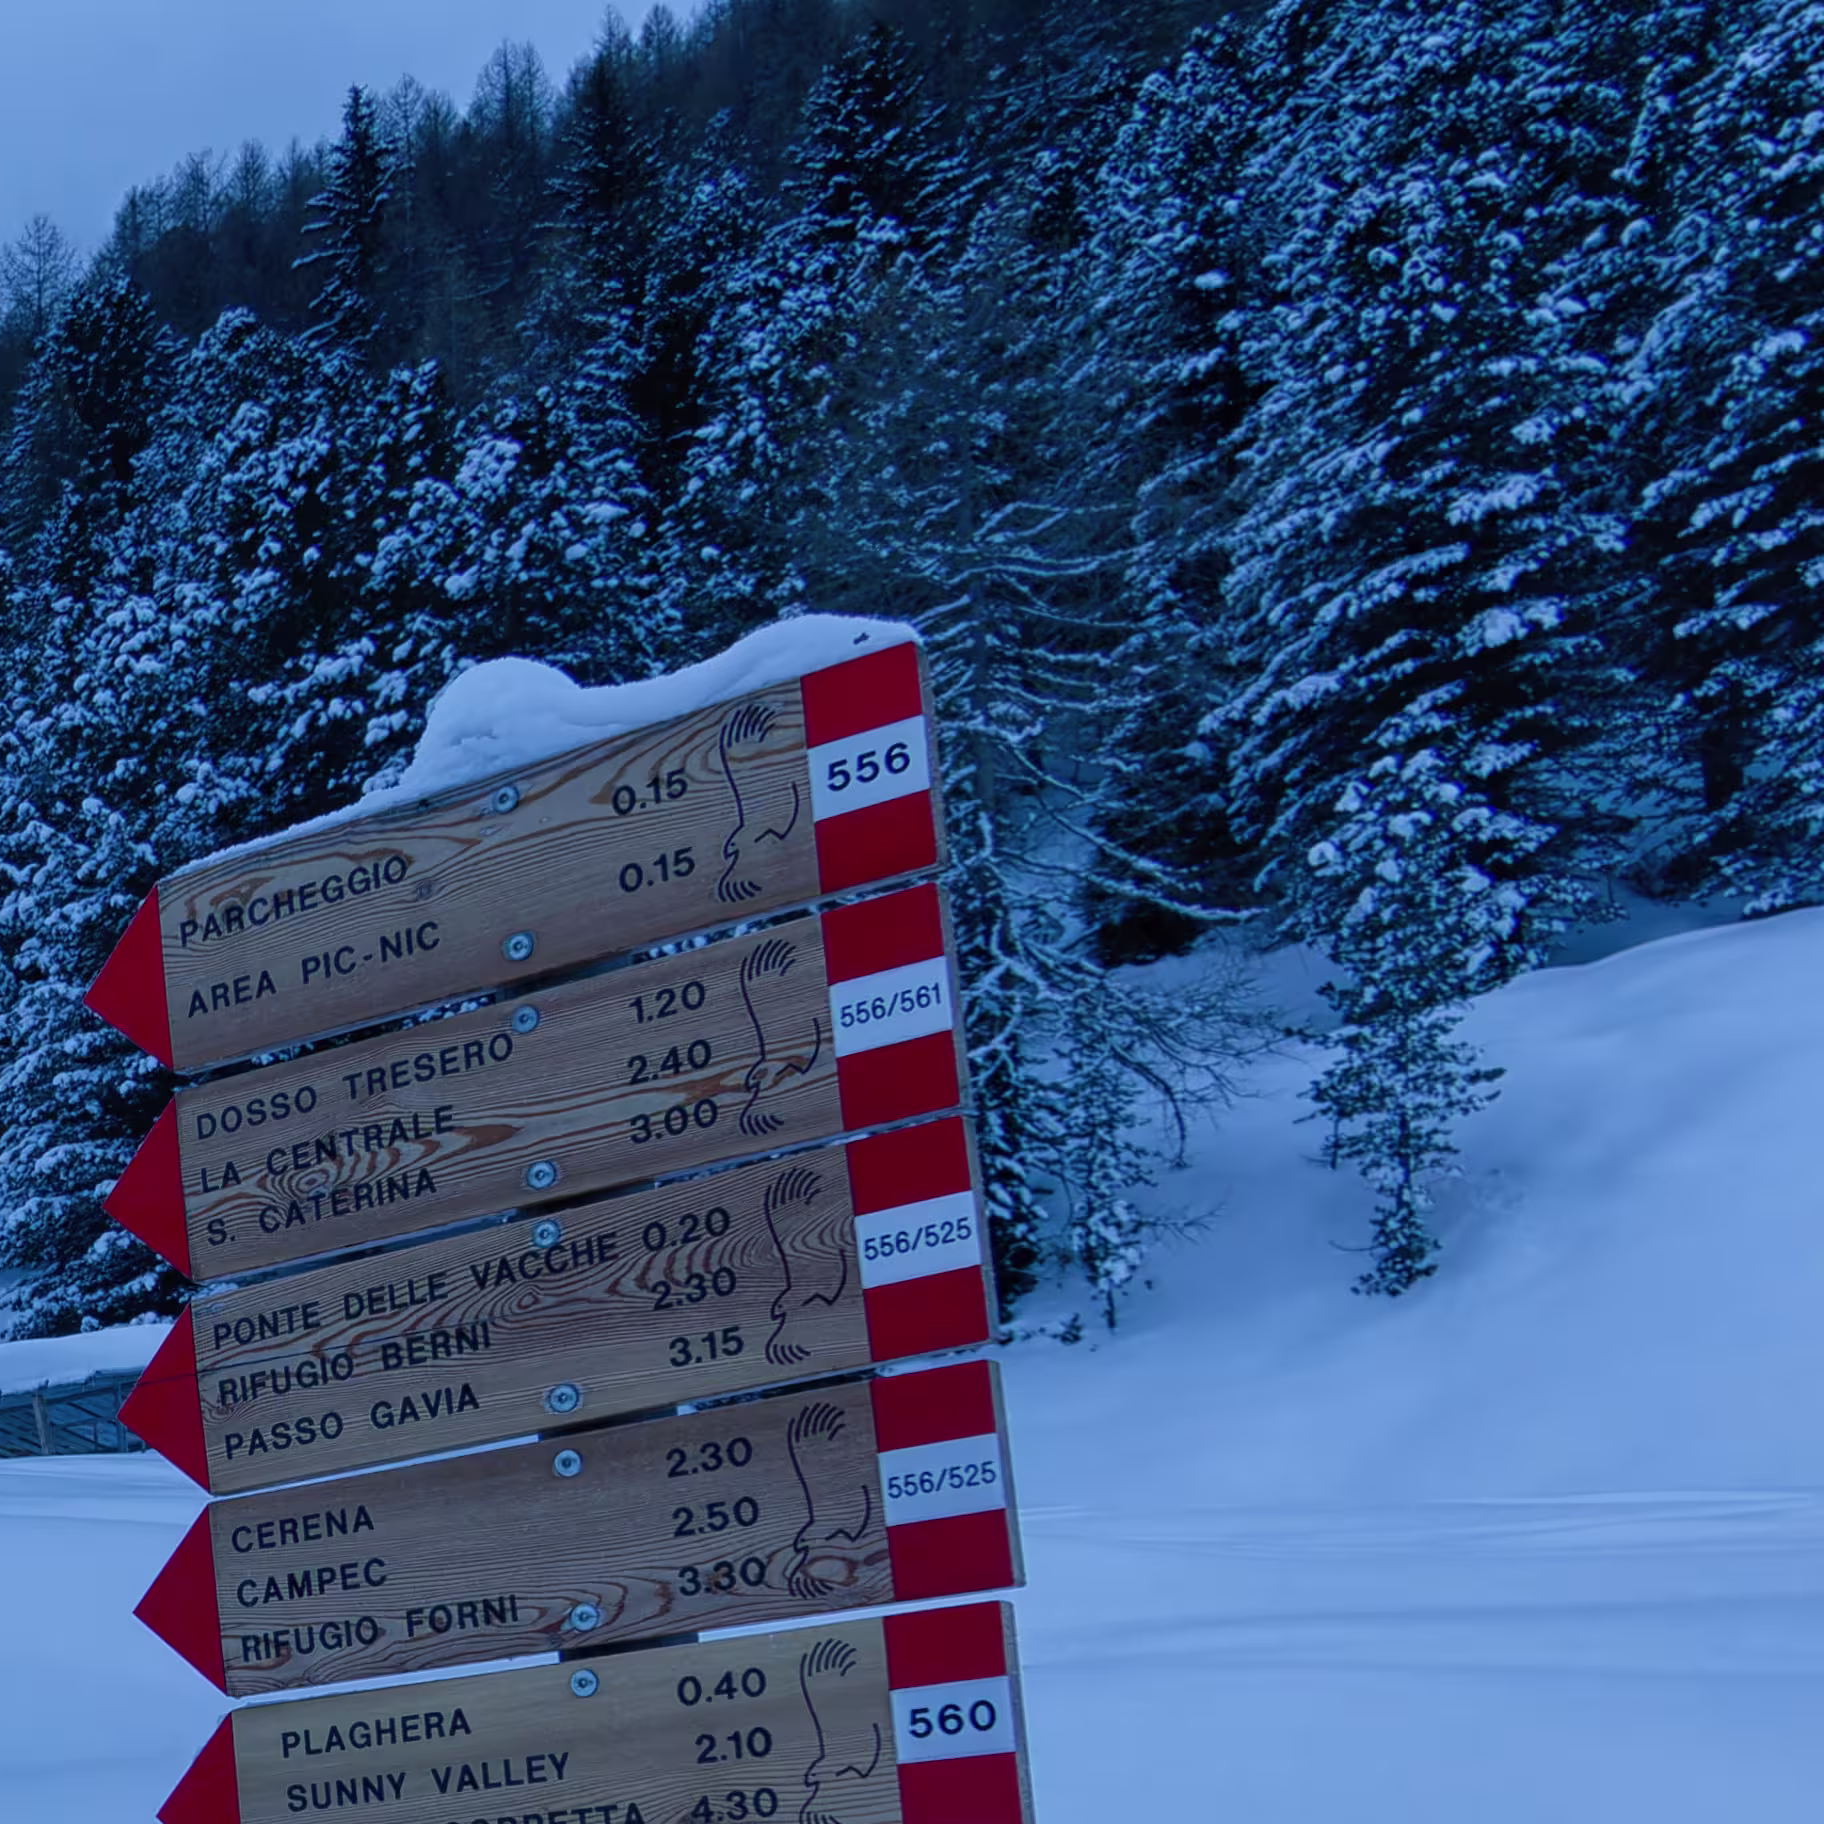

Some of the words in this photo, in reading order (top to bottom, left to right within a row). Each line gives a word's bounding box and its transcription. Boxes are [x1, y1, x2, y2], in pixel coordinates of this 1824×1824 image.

[826, 742, 911, 792] 556
[179, 855, 409, 948] PARCHEGGIO
[612, 768, 689, 816] 0.15
[188, 969, 277, 1018] AREA
[300, 923, 441, 987] PIC-NIC
[618, 847, 695, 894] 0.15
[197, 1086, 318, 1139] DOSSO
[343, 1031, 514, 1102] TRESERO
[630, 980, 706, 1026] 1.20
[840, 981, 943, 1027] 556/561
[200, 1153, 242, 1192] LA
[265, 1105, 455, 1177] CENTRALE
[628, 1039, 712, 1084] 2.40
[207, 1216, 236, 1246] S.
[259, 1168, 436, 1234] CATERINA
[630, 1100, 718, 1144] 3.00
[213, 1307, 326, 1350] PONTE
[343, 1277, 448, 1321] DELLE
[470, 1232, 619, 1290] VACCHE
[642, 1208, 731, 1250] 0.20
[864, 1218, 972, 1261] 556/525
[218, 1353, 351, 1407] RIFUGIO
[380, 1322, 491, 1370] BERNI
[651, 1268, 736, 1310] 2.30
[225, 1413, 344, 1460] PASSO
[369, 1384, 480, 1430] GAVIA
[669, 1328, 744, 1366] 3.15
[231, 1507, 375, 1553] CERENA
[666, 1438, 752, 1478] 2.30
[887, 1461, 997, 1499] 556/525
[237, 1559, 388, 1608] CAMPEC
[672, 1497, 759, 1537] 2.50
[241, 1617, 378, 1663] RIFUGIO
[407, 1594, 519, 1636] FORNI
[678, 1558, 766, 1596] 3.30
[282, 1709, 471, 1760] PLAGHERA
[677, 1668, 767, 1707] 0.40
[908, 1699, 997, 1738] 560
[287, 1765, 417, 1814] SUNNY
[432, 1751, 570, 1798] VALLEY
[695, 1726, 773, 1765] 2.10
[692, 1787, 779, 1824] 4.30
